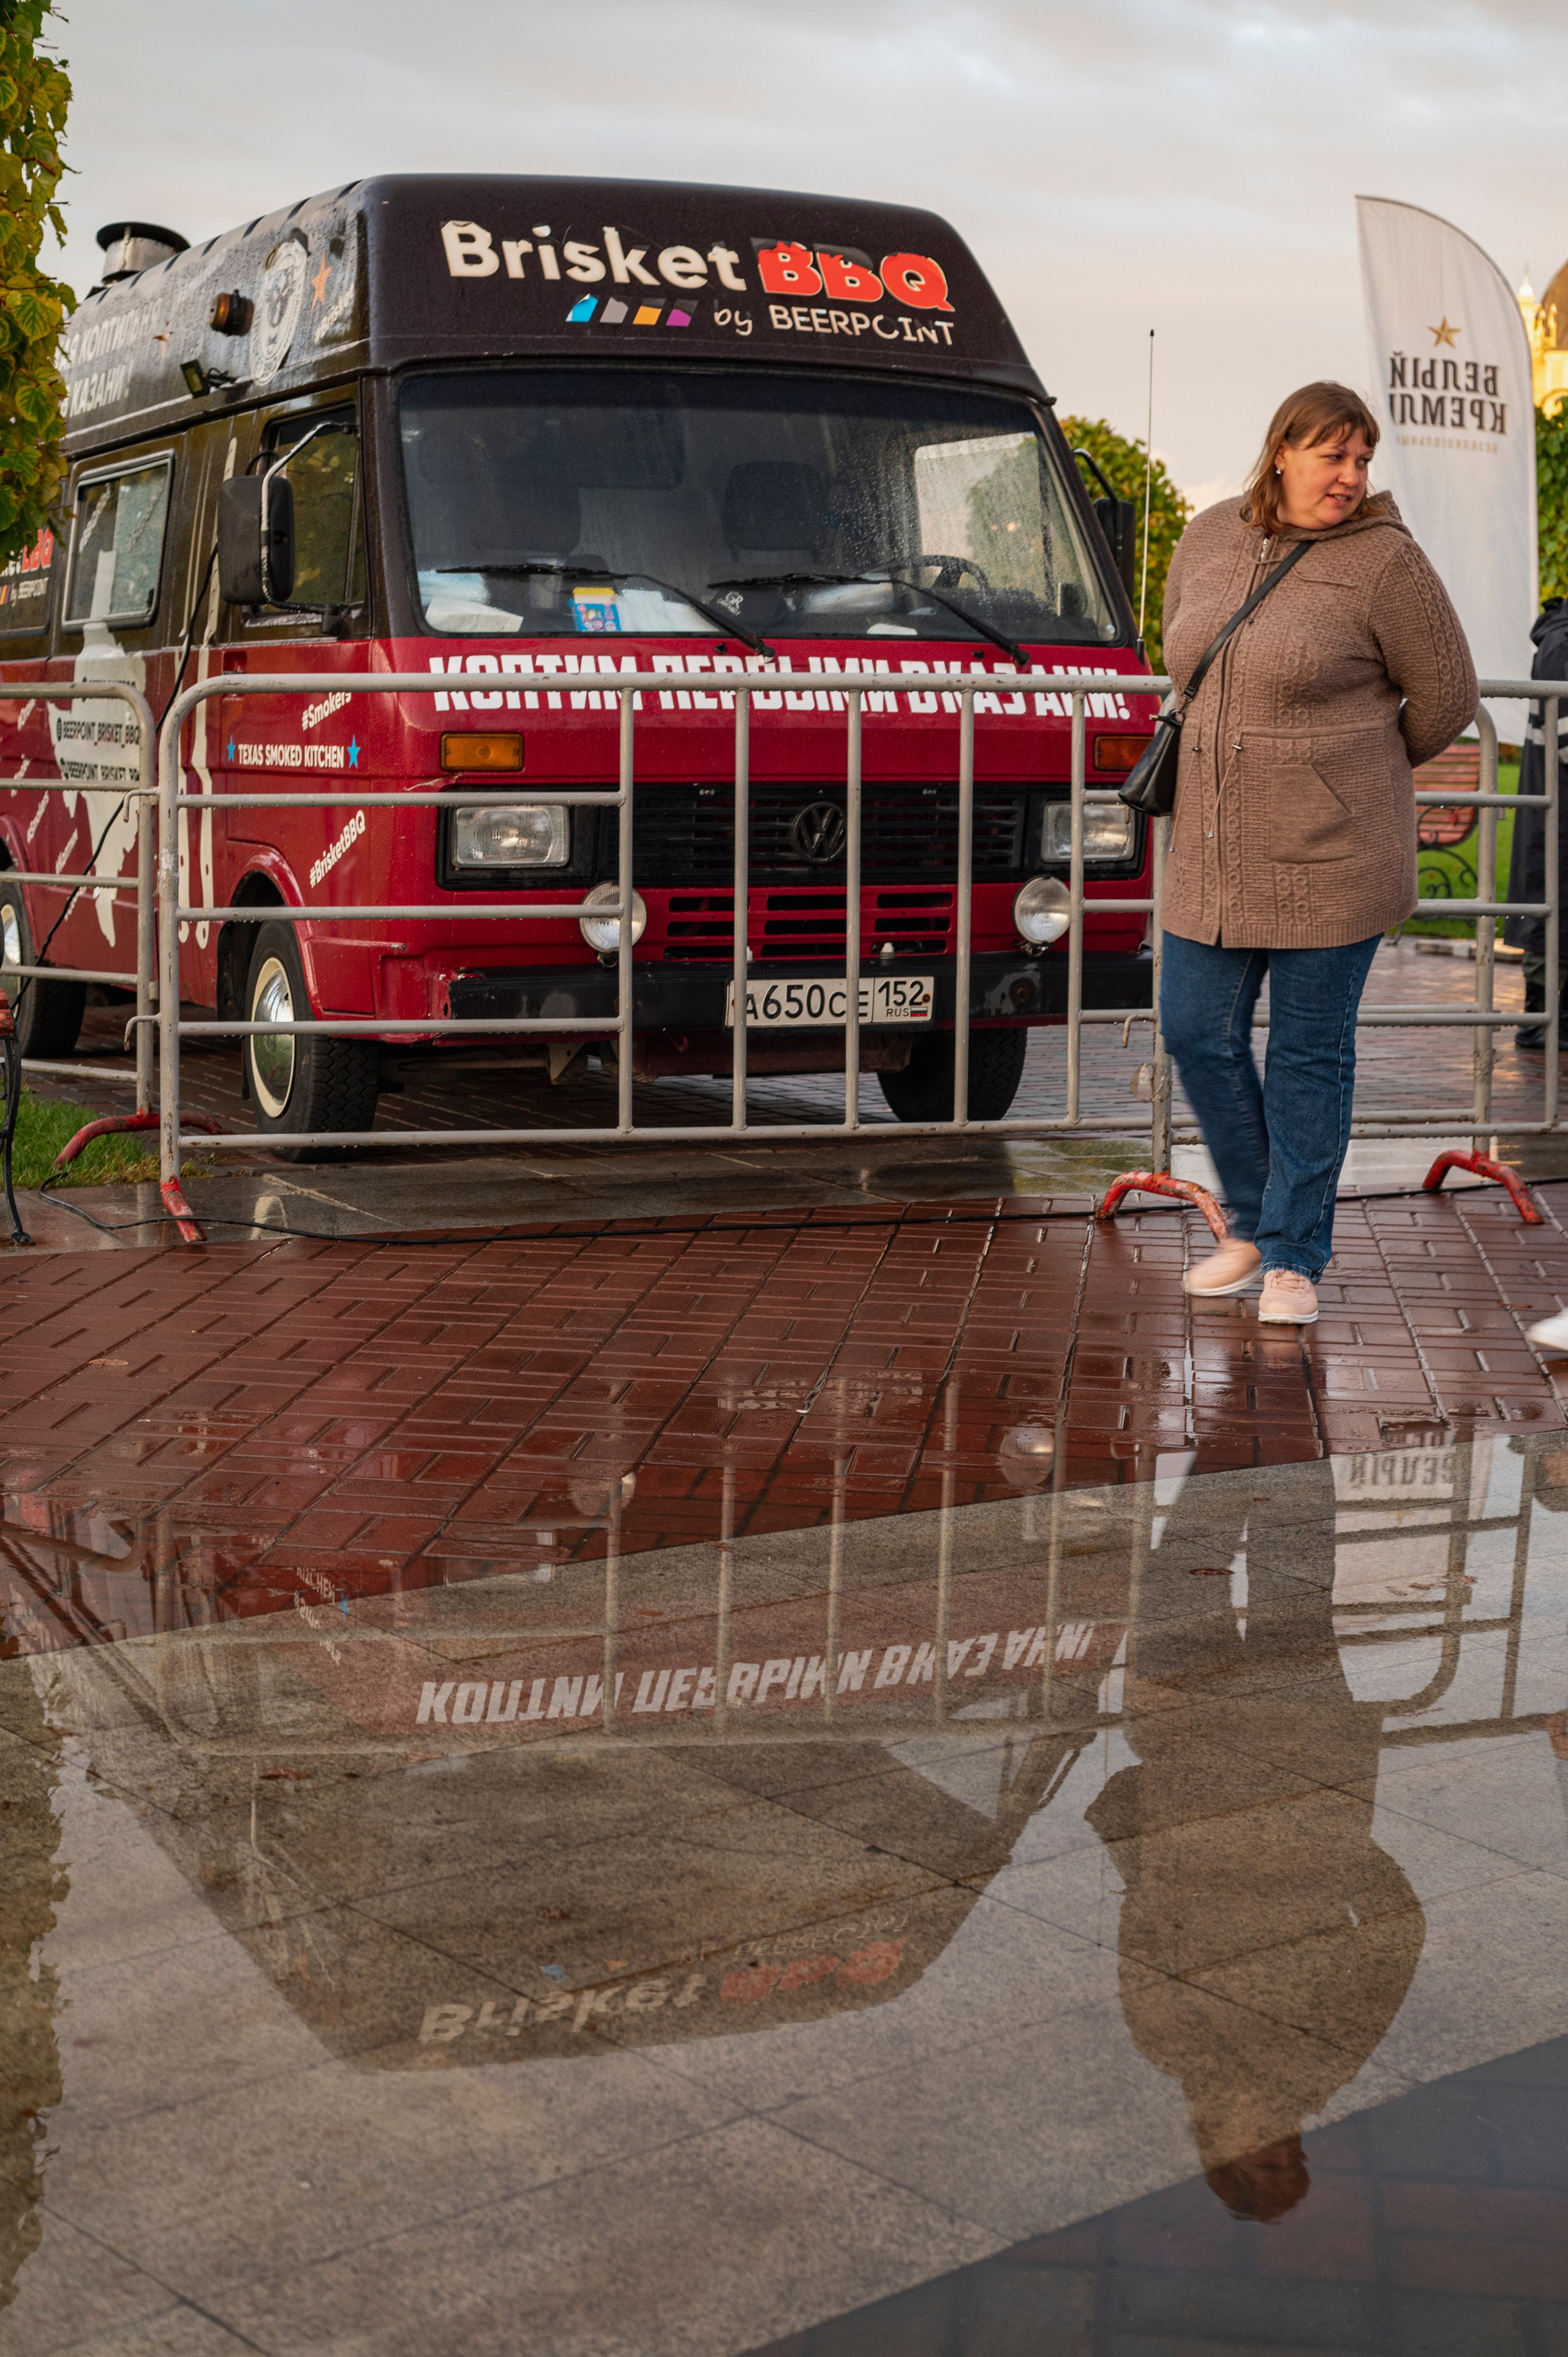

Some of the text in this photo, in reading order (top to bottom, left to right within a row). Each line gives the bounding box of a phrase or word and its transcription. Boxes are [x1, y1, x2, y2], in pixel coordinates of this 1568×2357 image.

[440, 220, 956, 312] Brisket BBQ
[714, 301, 753, 336] by
[238, 744, 345, 768] TEXAS SMOKED KITCHEN
[309, 810, 366, 889] #BrisketBBQ
[877, 980, 925, 1008] 152
[886, 1007, 910, 1018] RUS
